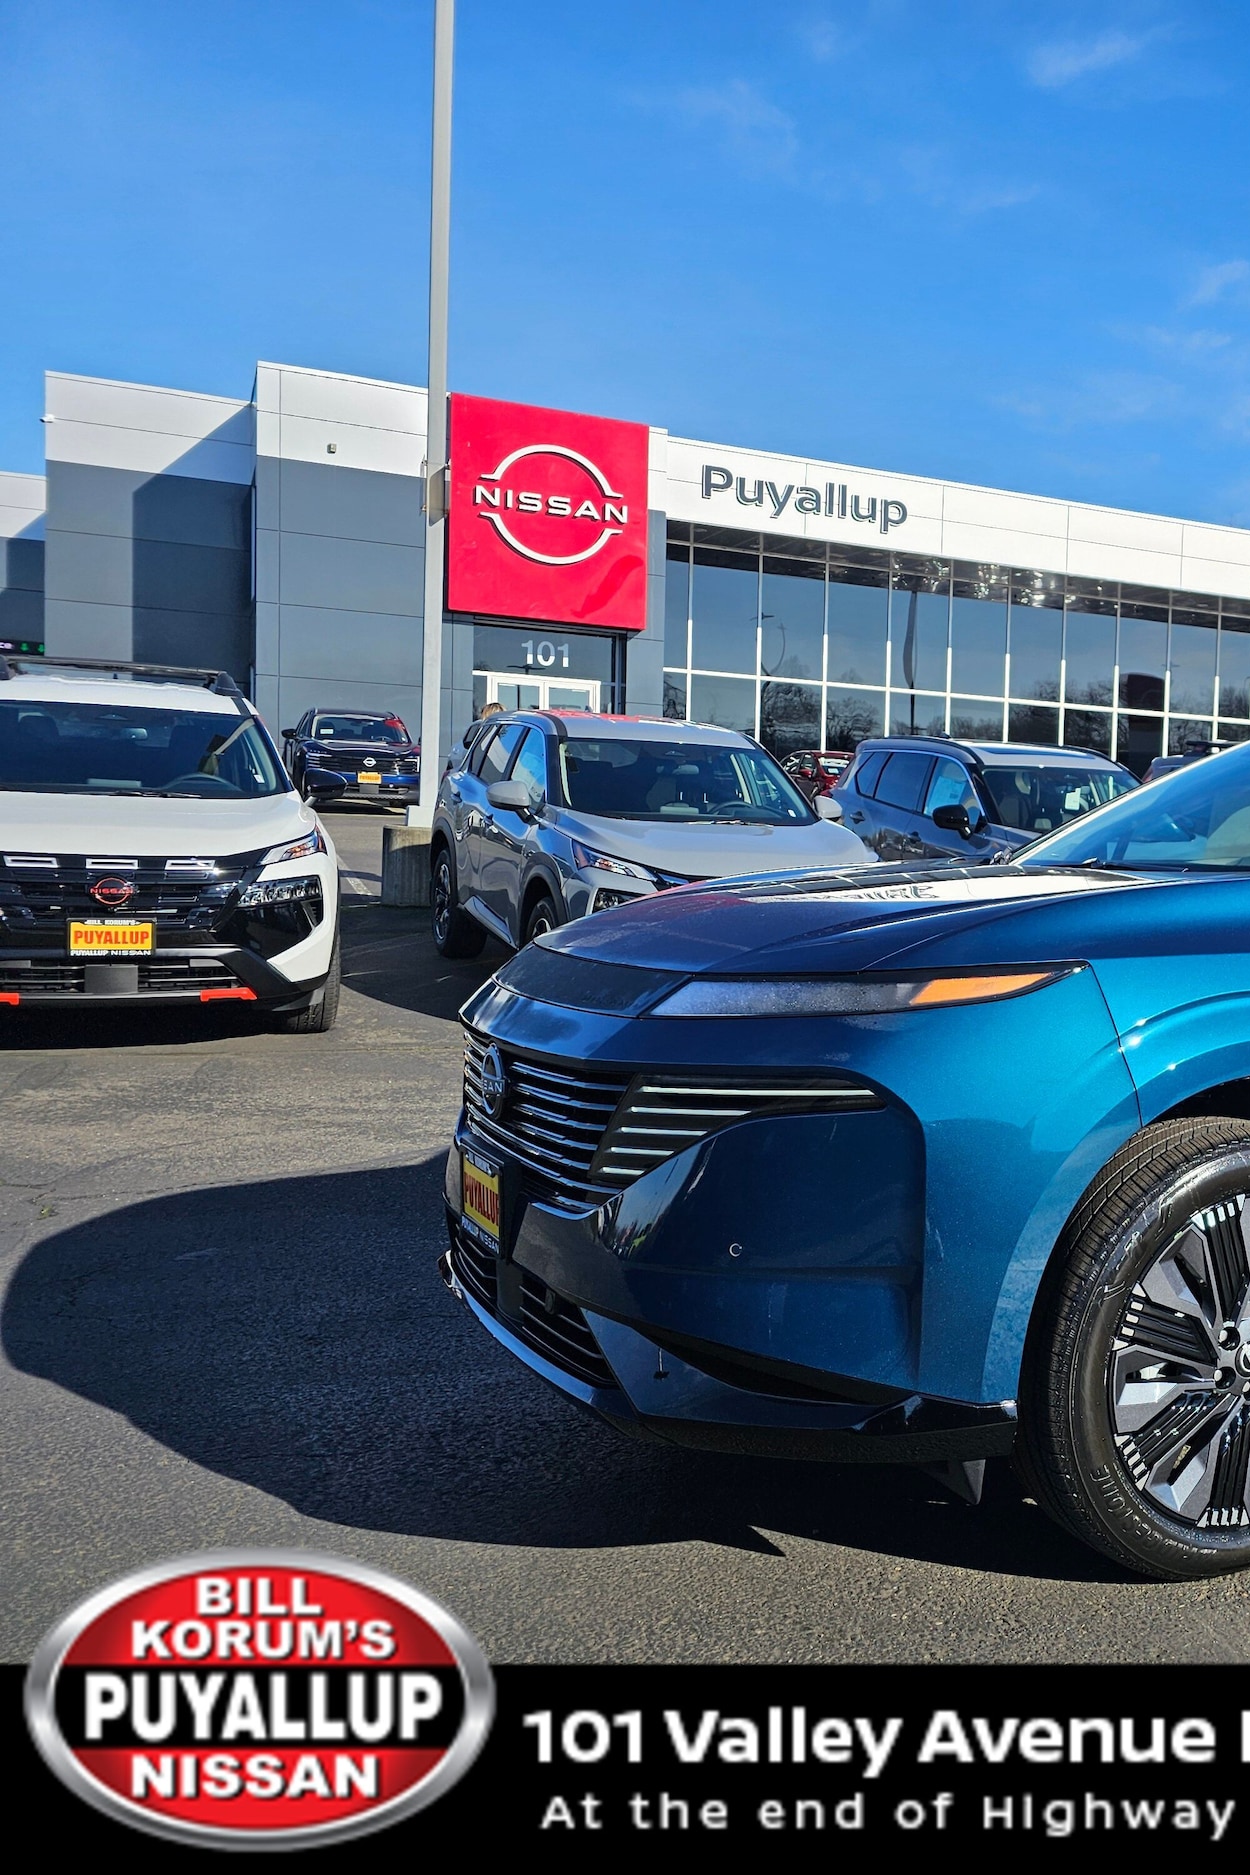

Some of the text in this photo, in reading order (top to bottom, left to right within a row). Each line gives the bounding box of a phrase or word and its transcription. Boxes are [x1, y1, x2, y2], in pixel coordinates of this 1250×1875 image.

[473, 485, 628, 524] NISSAN
[701, 464, 908, 534] Puyallup
[521, 640, 569, 668] 101
[73, 930, 150, 945] PUYALLUP
